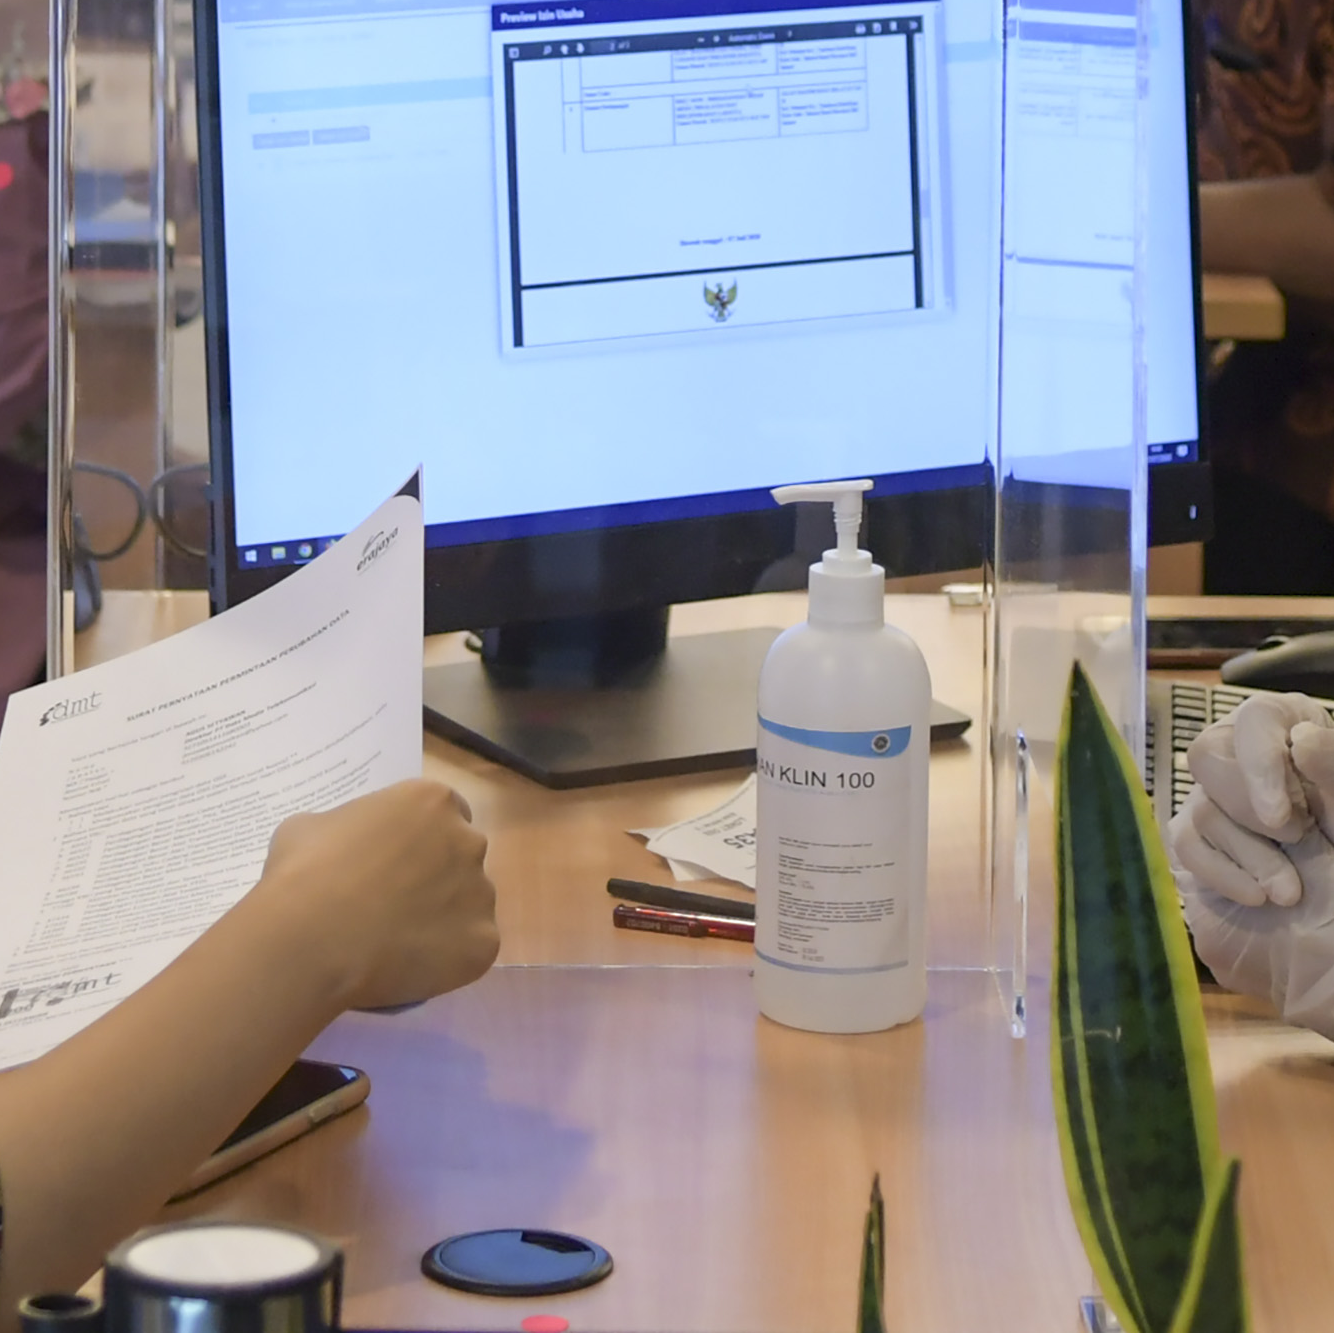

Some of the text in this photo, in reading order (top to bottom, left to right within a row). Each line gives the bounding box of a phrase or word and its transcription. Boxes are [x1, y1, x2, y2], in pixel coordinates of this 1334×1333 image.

[500, 10, 537, 24] Preview
[356, 527, 399, 571] erajaya
[127, 609, 350, 722] SURAT PERNYATAAN PERMINTAAN PERUBAHAN DATA
[51, 690, 103, 720] dmt
[758, 758, 775, 778] AN
[780, 765, 827, 788] KLIN
[837, 772, 875, 789] 100
